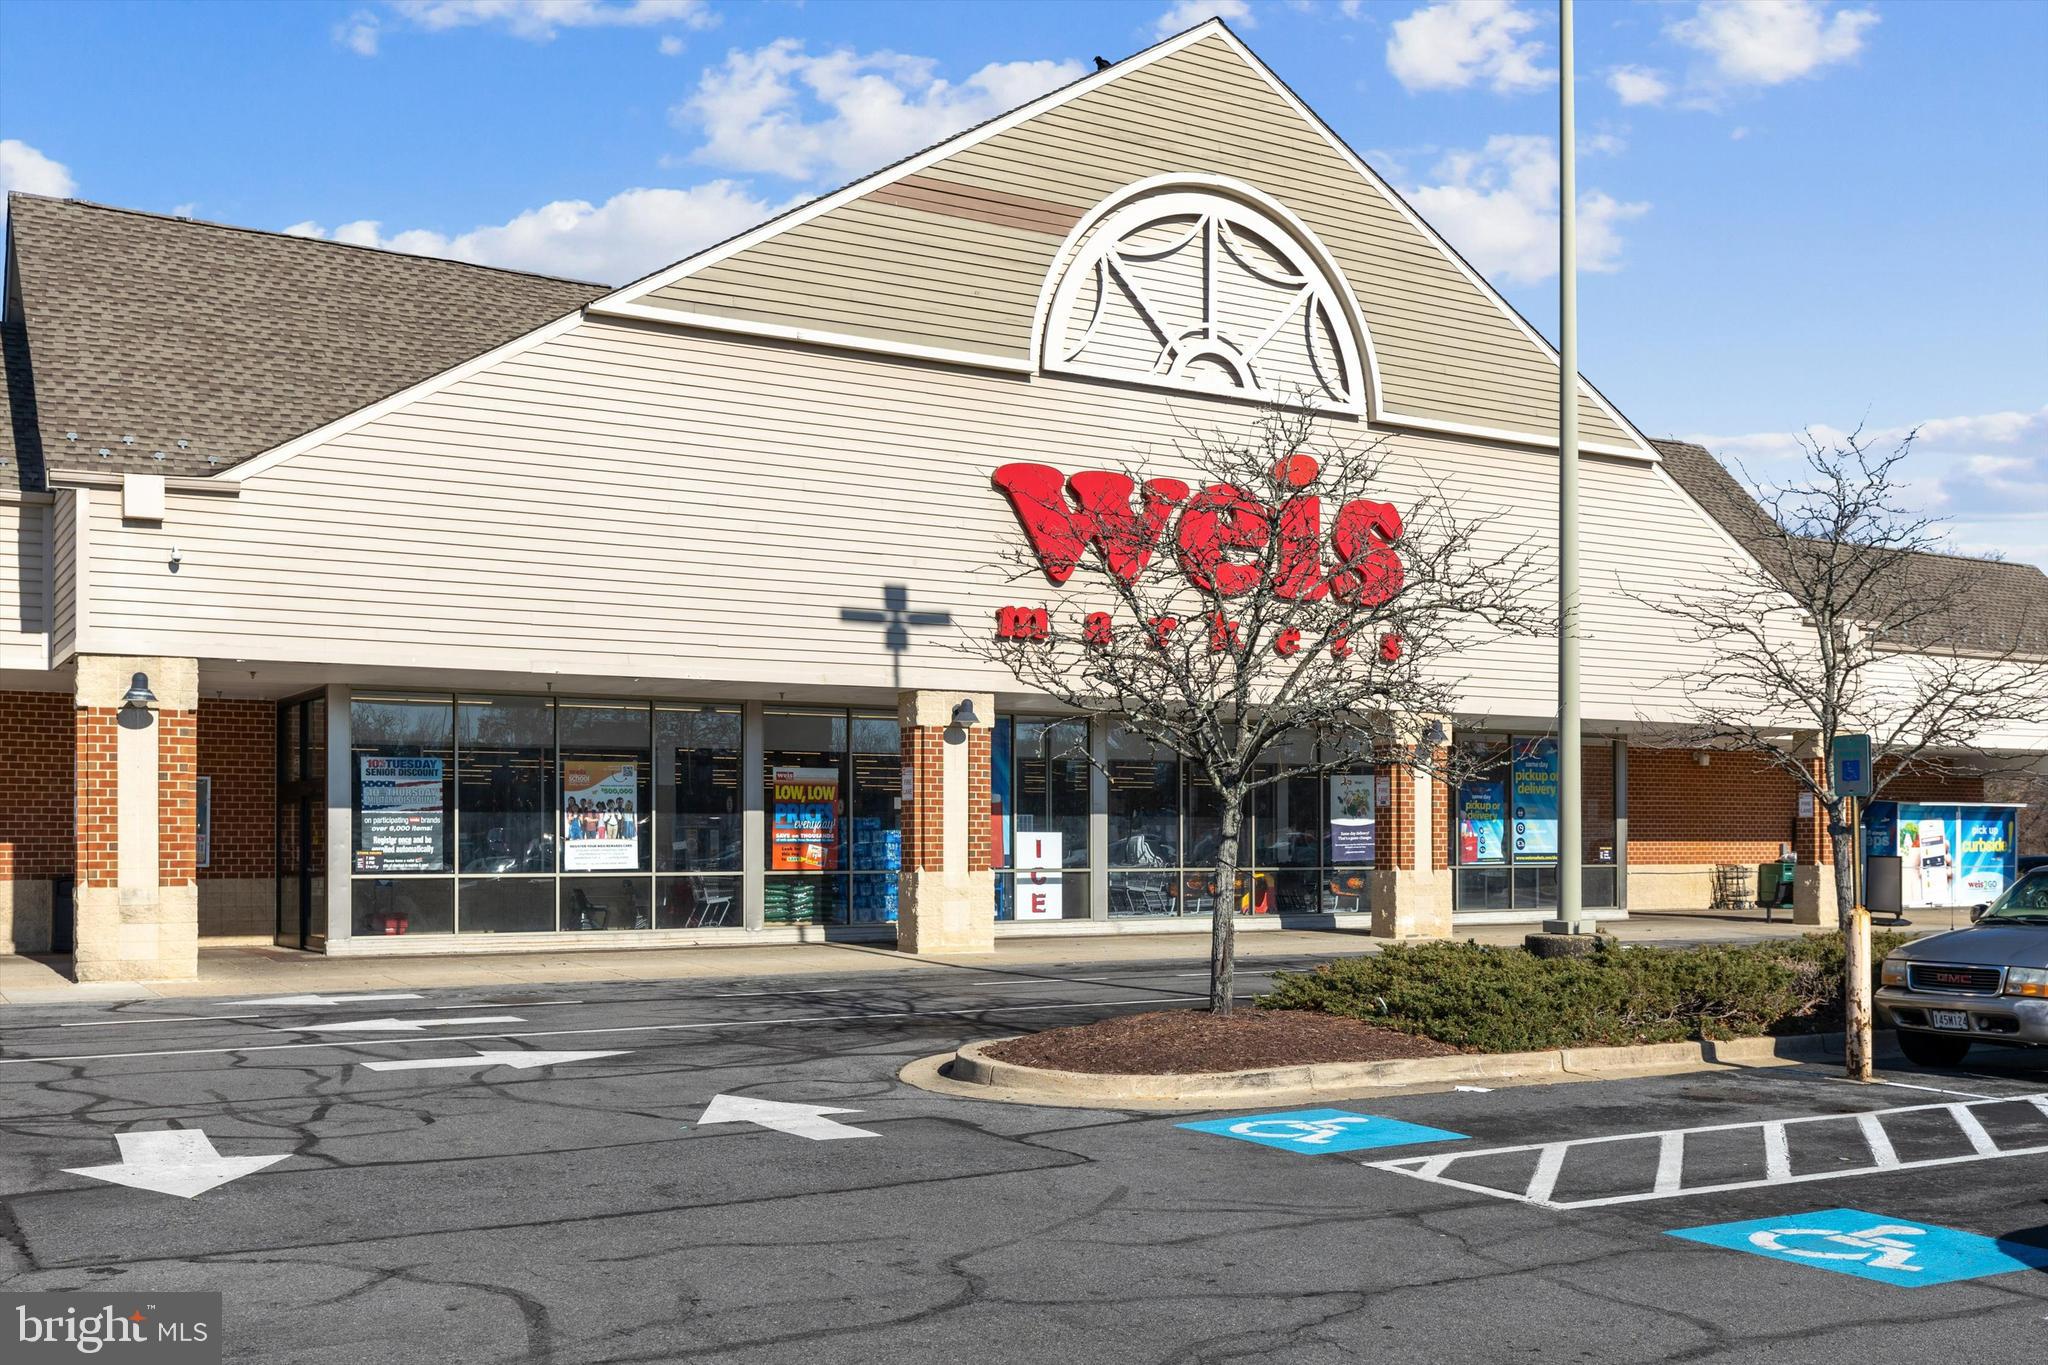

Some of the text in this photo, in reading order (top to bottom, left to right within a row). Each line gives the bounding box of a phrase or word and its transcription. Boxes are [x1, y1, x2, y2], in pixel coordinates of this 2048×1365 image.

[385, 759, 437, 769] TUESDAY
[365, 768, 439, 777] SENIOR DISCOUNT
[1515, 768, 1549, 784] pickup
[775, 784, 836, 803] LOW, LOW
[1518, 782, 1556, 797] delivery
[1465, 800, 1491, 812] pickup
[775, 802, 834, 824] PRICES
[1467, 810, 1498, 821] delivery
[373, 816, 409, 825] participating
[420, 816, 441, 824] brands
[389, 825, 411, 833] 6,000
[1971, 824, 2000, 837] pick up
[372, 836, 397, 846] Register
[413, 836, 424, 844] and
[424, 836, 433, 844] be
[395, 845, 435, 855] automatically
[1936, 973, 1972, 984] GMC
